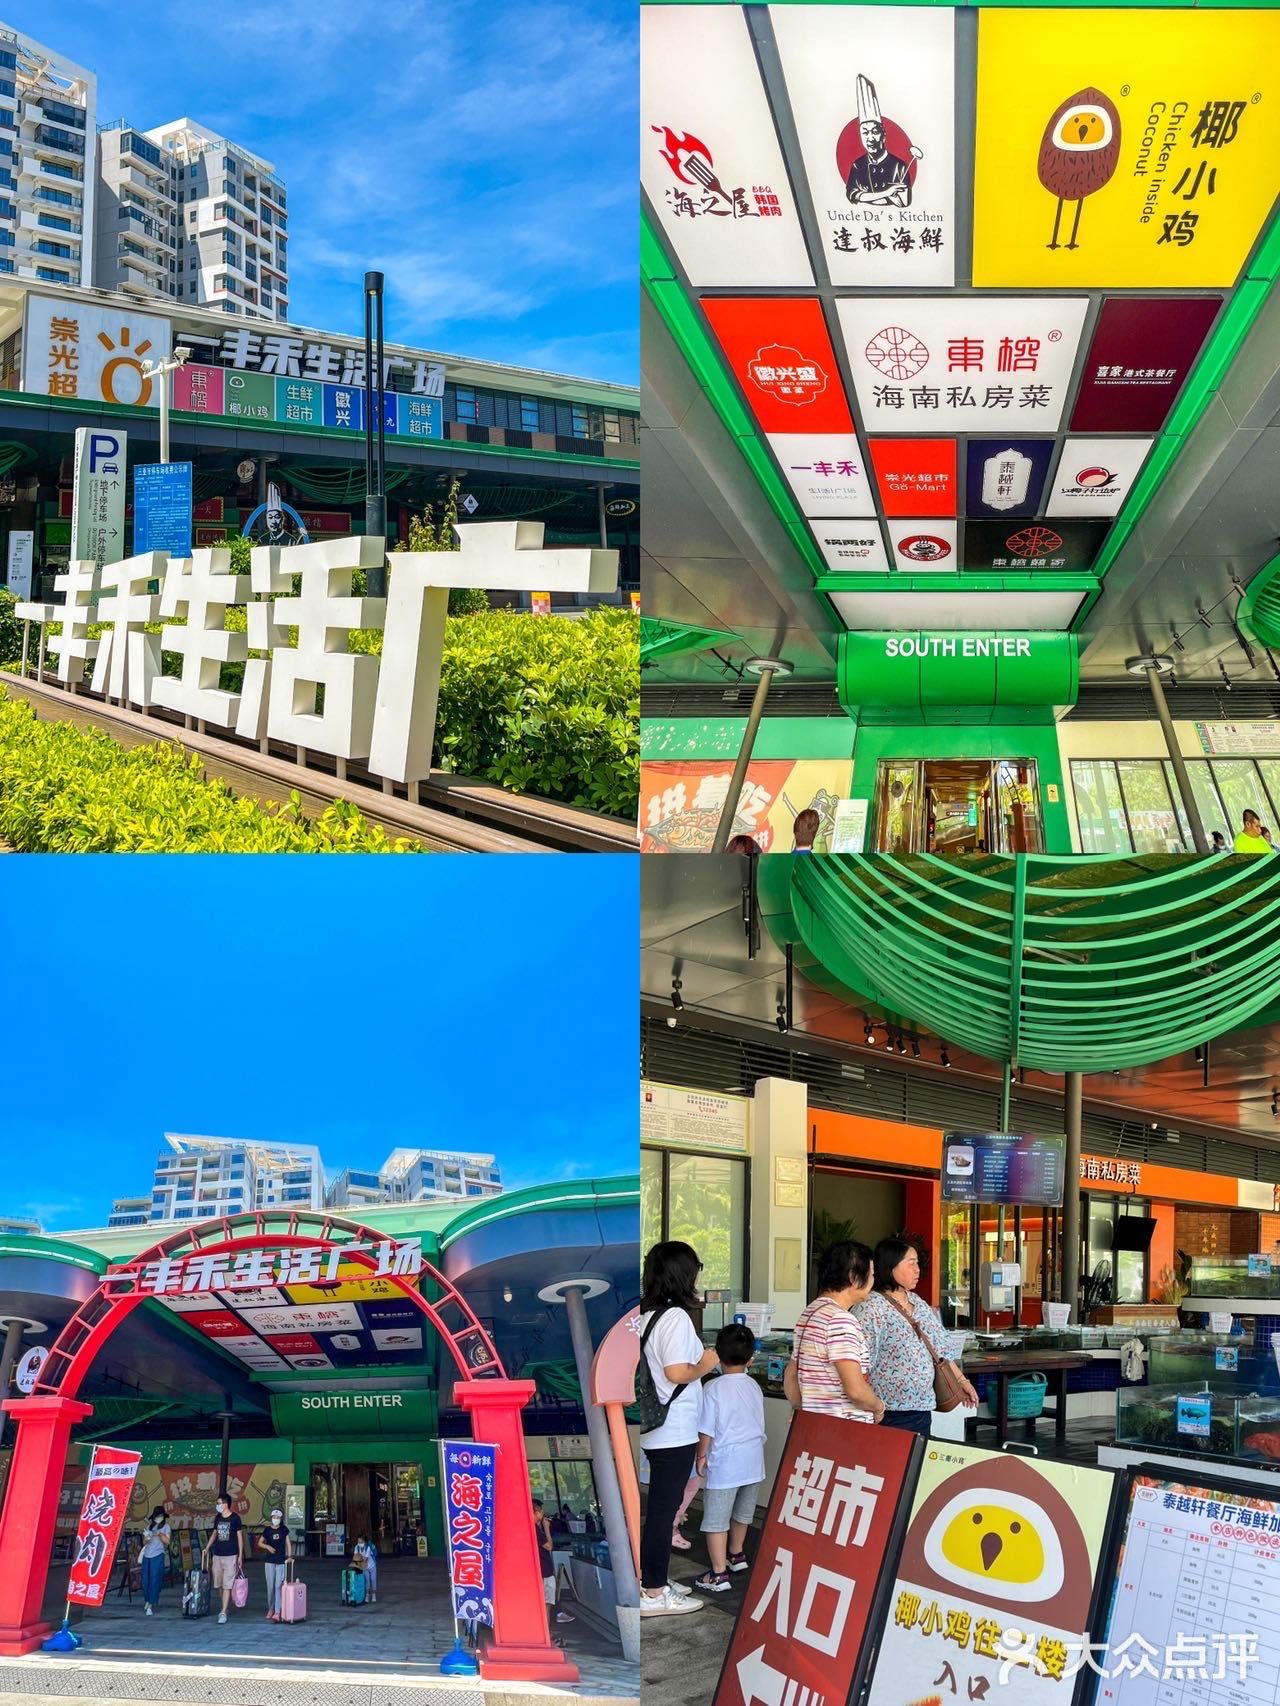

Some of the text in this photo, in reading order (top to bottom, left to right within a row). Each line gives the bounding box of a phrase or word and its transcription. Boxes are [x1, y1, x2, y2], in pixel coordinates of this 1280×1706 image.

[1133, 101, 1167, 178] Coconut
[1140, 101, 1189, 225] Chicken inside
[1155, 101, 1247, 247] 椰小鸡
[665, 186, 760, 219] 海之屋
[751, 185, 773, 194] BBQ
[827, 210, 861, 222] Uncle
[899, 210, 943, 223] Kitchen
[832, 226, 944, 254] 達叔海鮮
[177, 328, 446, 398] 一丰禾生活广场
[229, 402, 269, 418] 椰小鸡
[286, 384, 313, 402] 生鲜
[335, 391, 351, 426] 徽兴
[409, 400, 432, 417] 海鲜
[872, 384, 1053, 409] 海南私房菜
[286, 404, 313, 421] 超市
[409, 420, 433, 435] 超市
[90, 434, 119, 473] P
[790, 460, 859, 477] 一丰禾
[15, 520, 619, 784] 一丰禾生活广
[885, 638, 1032, 658] SOUTH ENTER
[98, 1237, 422, 1294] 一丰禾生活广场
[301, 1394, 403, 1409] SOUTH ENTER
[777, 1451, 885, 1548] 超市
[1162, 1492, 1280, 1534] 泰越轩餐厅海鲜加
[451, 1472, 485, 1591] 海之屋
[750, 1546, 856, 1659] 入口
[933, 1660, 990, 1701] 入口
